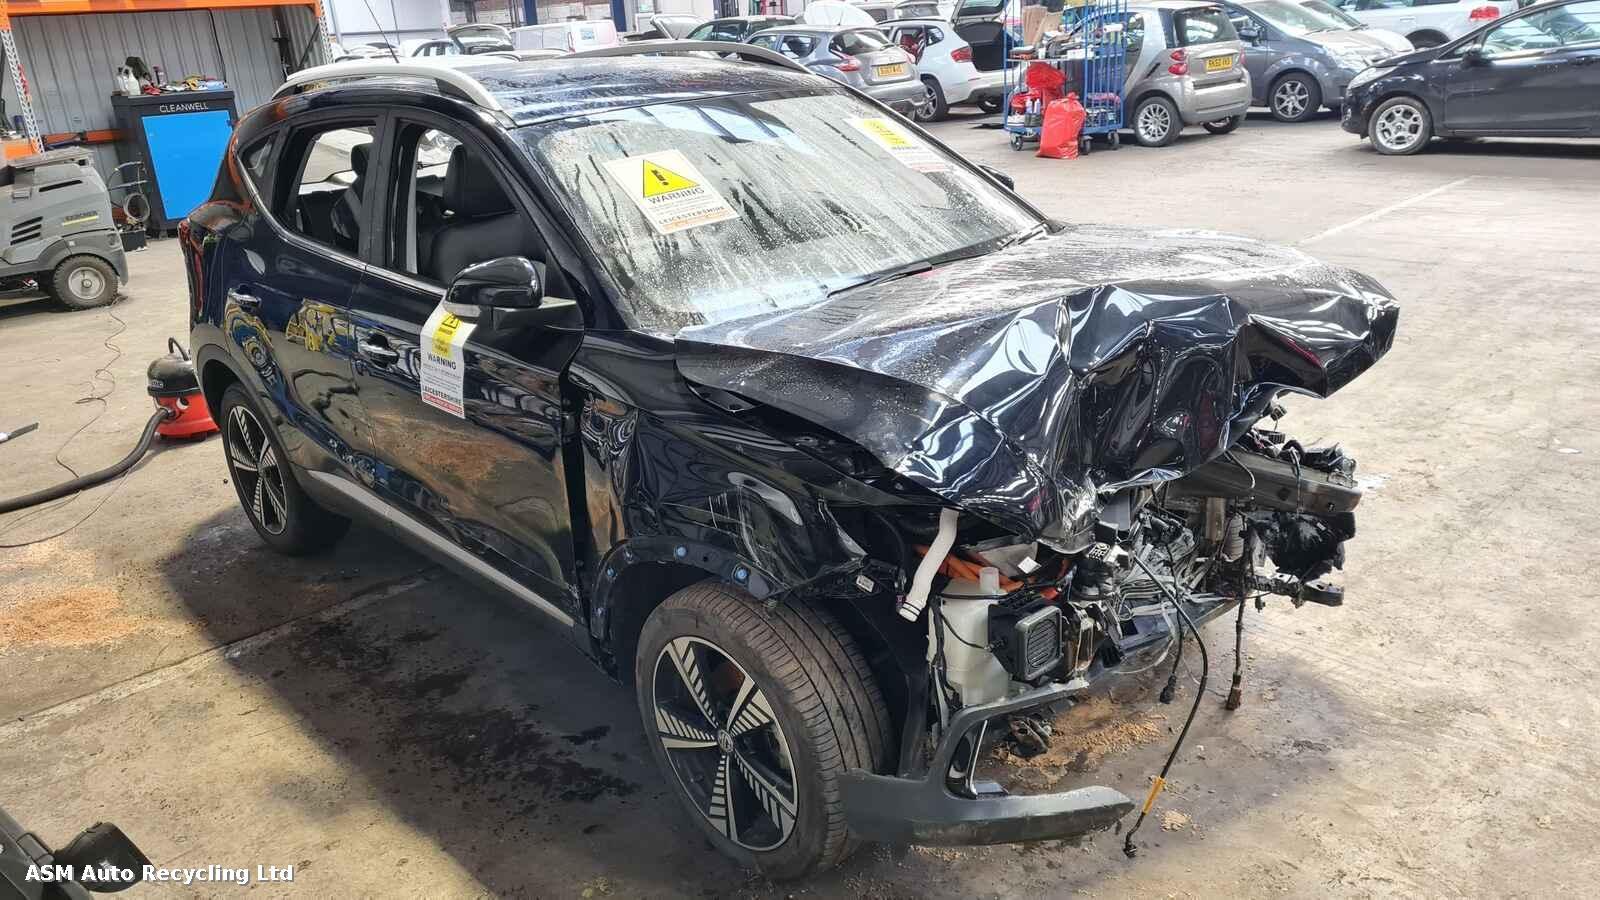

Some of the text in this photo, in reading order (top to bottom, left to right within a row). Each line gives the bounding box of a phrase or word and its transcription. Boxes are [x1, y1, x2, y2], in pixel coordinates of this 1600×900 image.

[159, 103, 208, 113] CLEANWELL
[648, 187, 705, 205] WARNING
[427, 353, 457, 370] WARNING
